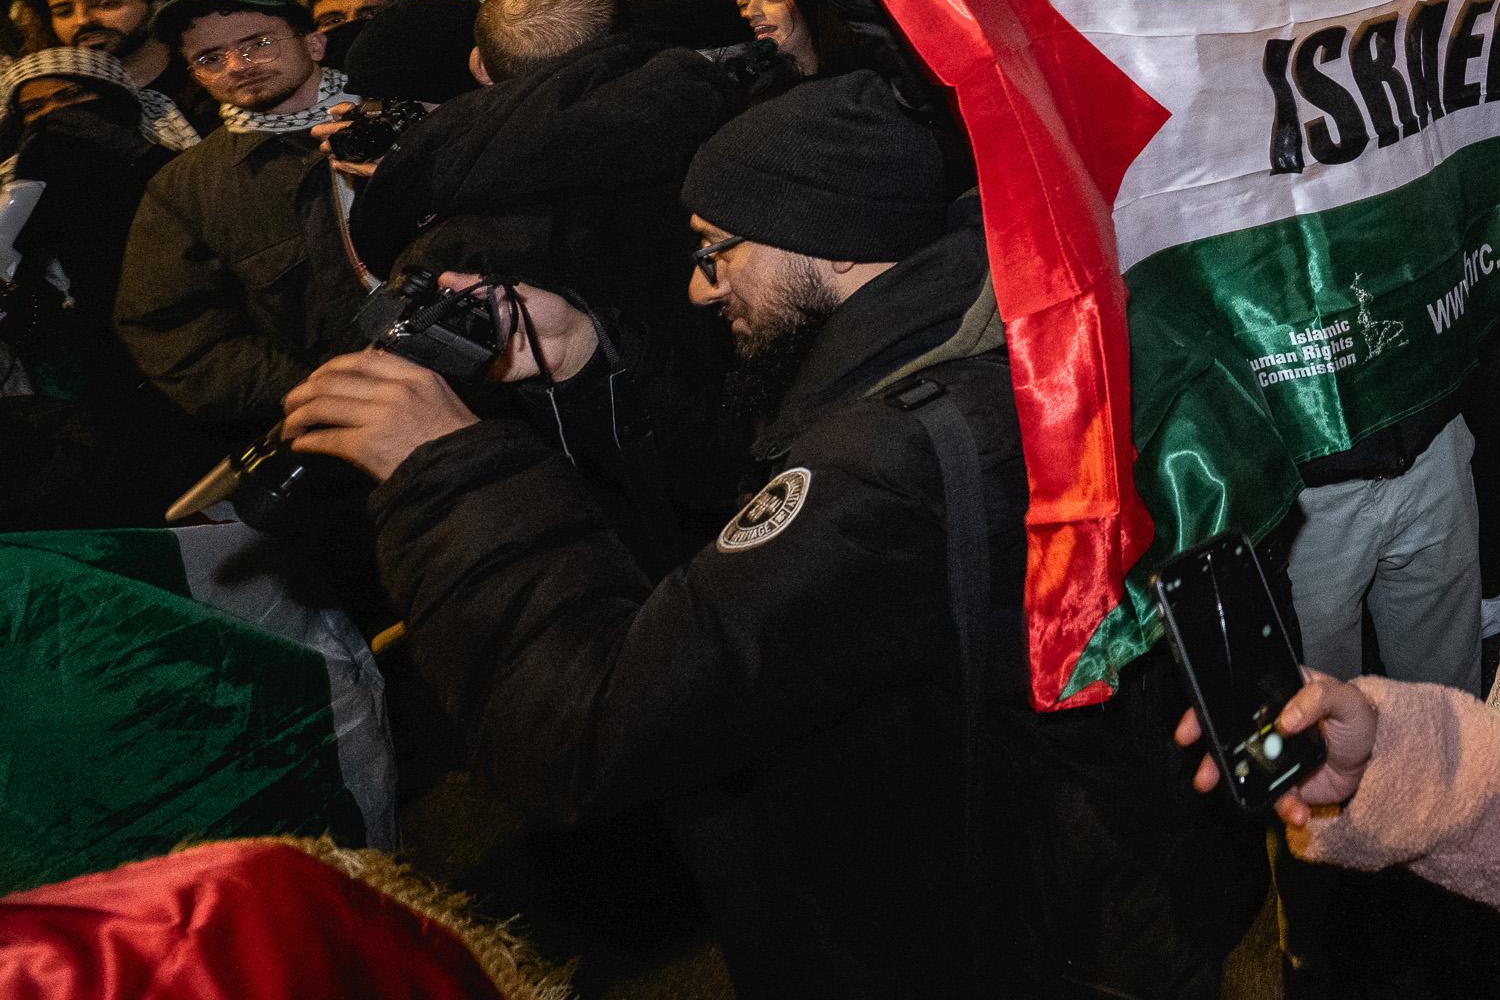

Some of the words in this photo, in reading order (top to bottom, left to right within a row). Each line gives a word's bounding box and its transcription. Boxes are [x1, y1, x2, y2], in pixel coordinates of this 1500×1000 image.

[1289, 319, 1351, 345] Islamic
[1248, 351, 1298, 371] uman
[1302, 336, 1354, 361] Rights
[1258, 352, 1357, 388] Commission
